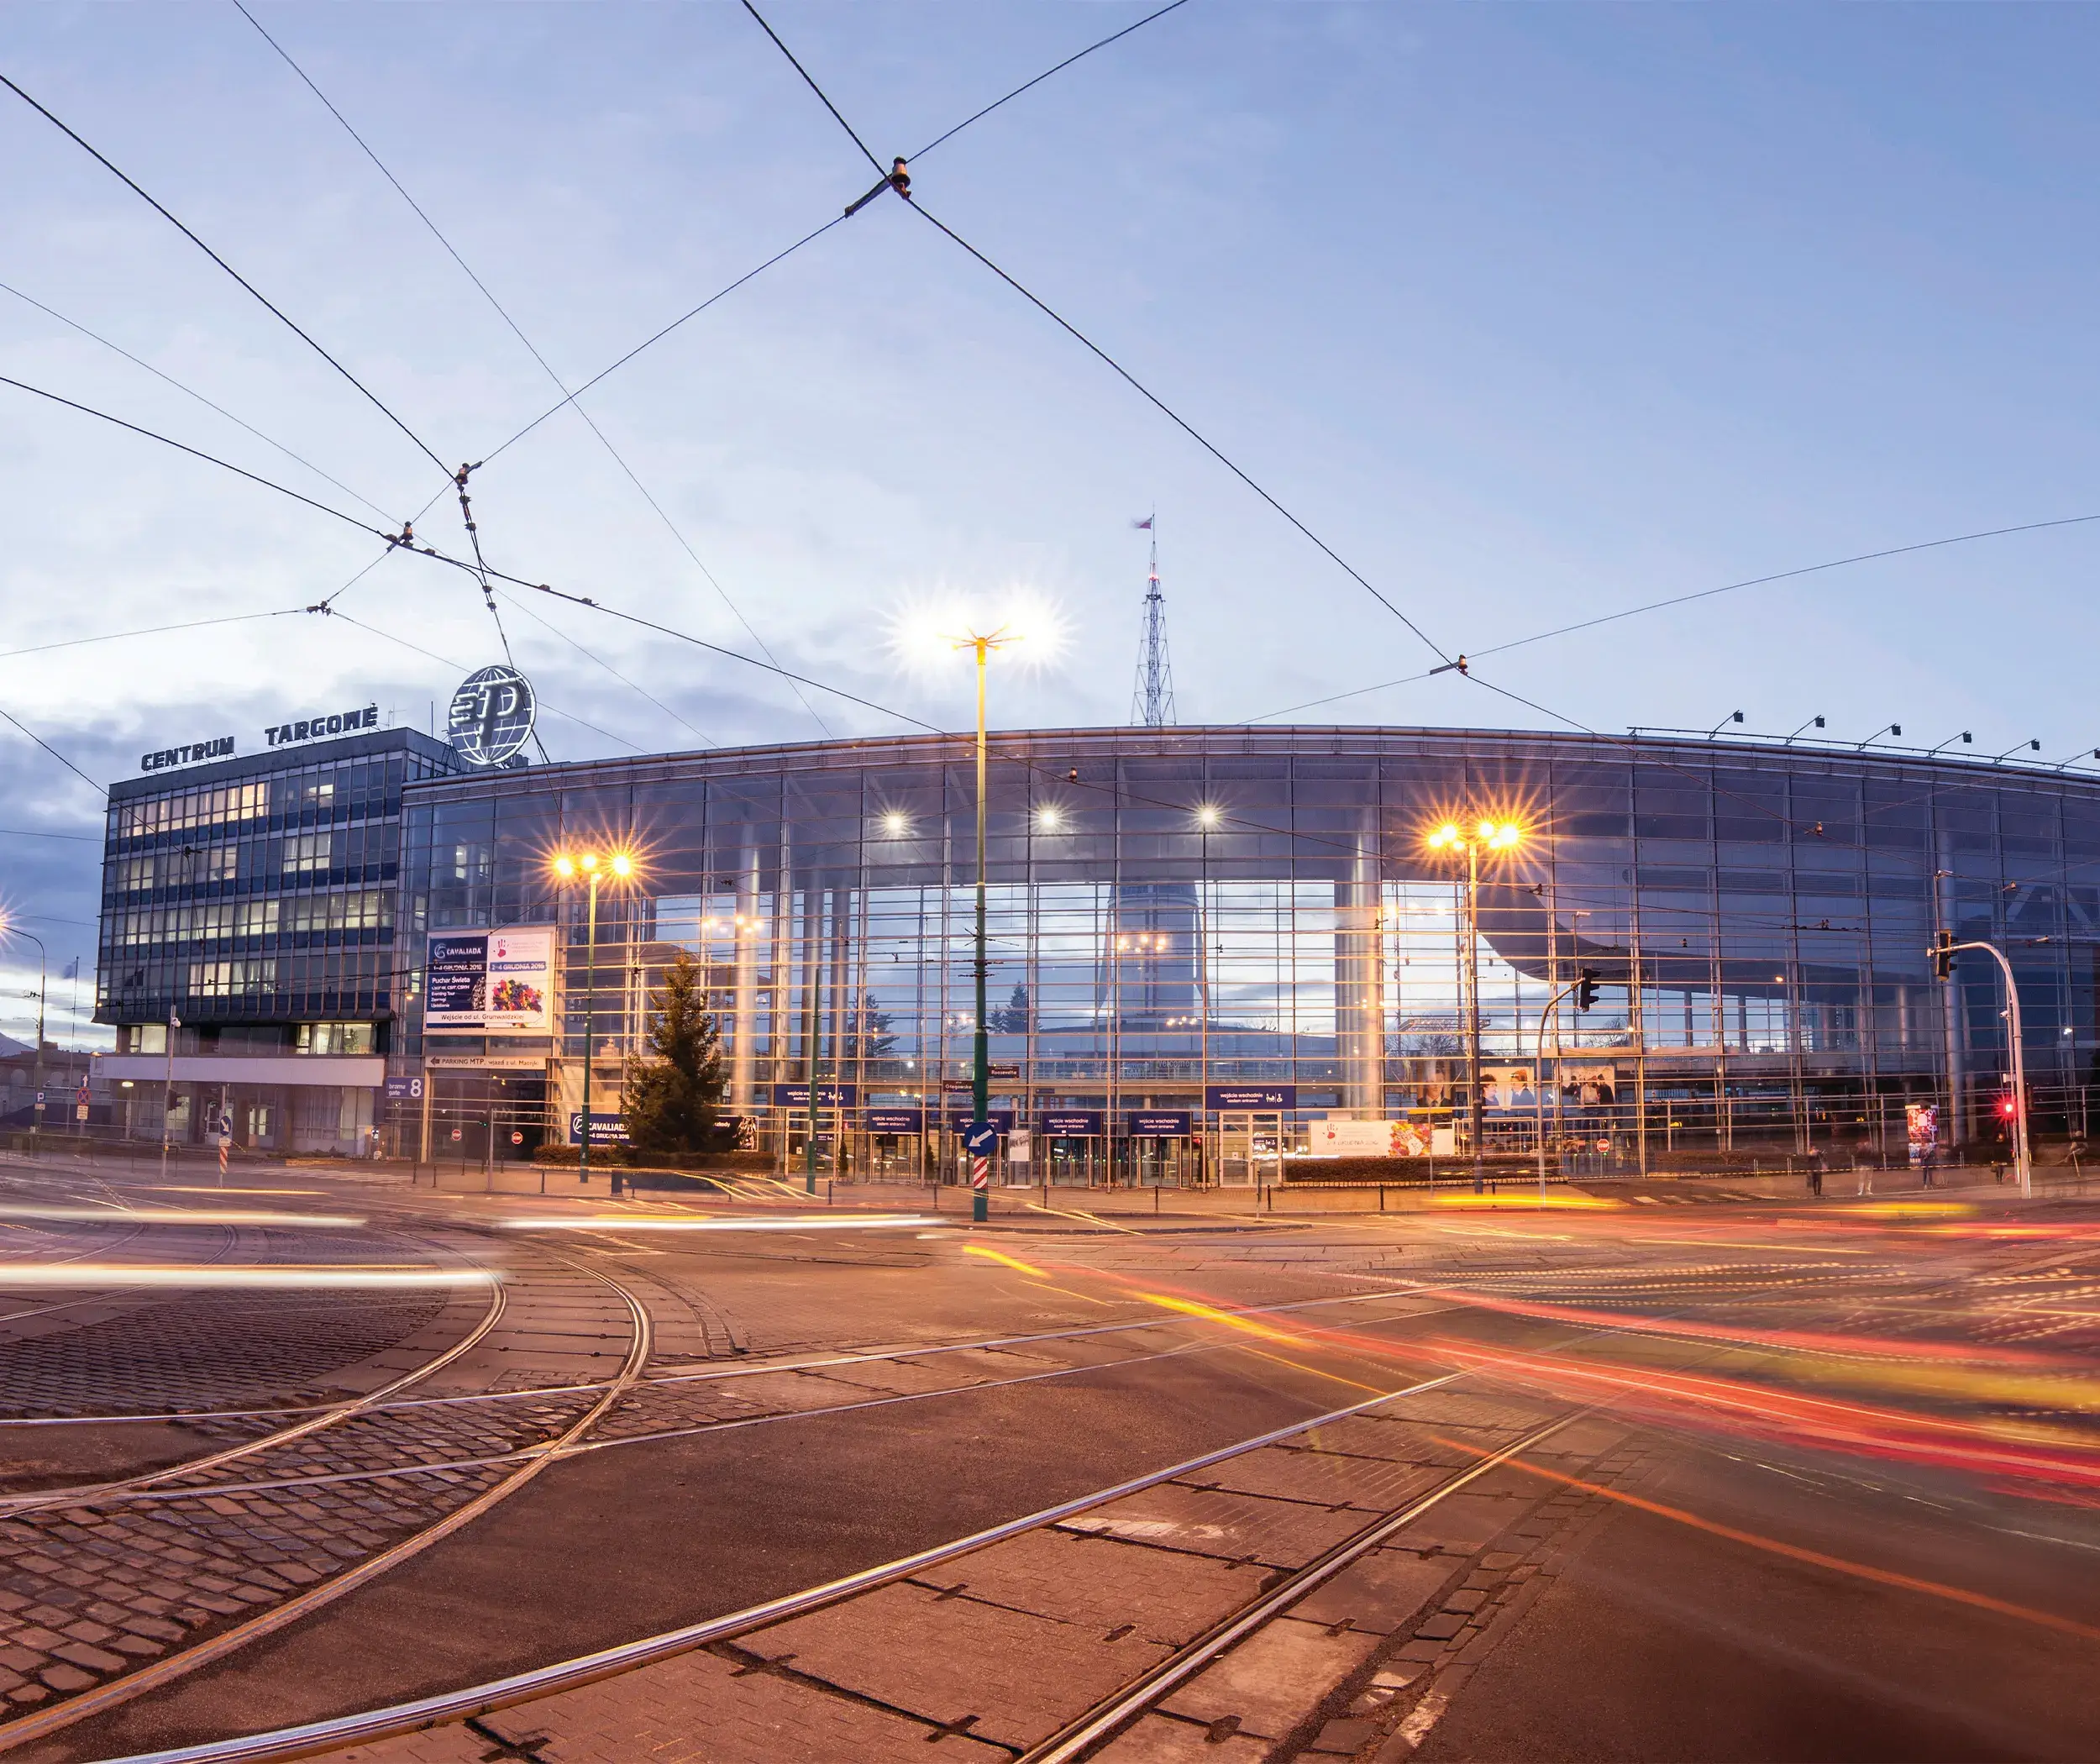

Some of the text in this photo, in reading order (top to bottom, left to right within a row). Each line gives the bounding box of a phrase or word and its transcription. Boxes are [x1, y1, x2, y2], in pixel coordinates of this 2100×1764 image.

[141, 706, 378, 771] CENTRUM TARGOWE
[446, 947, 482, 955] CAVALIADA
[410, 1079, 422, 1097] 8
[38, 1093, 45, 1102] P
